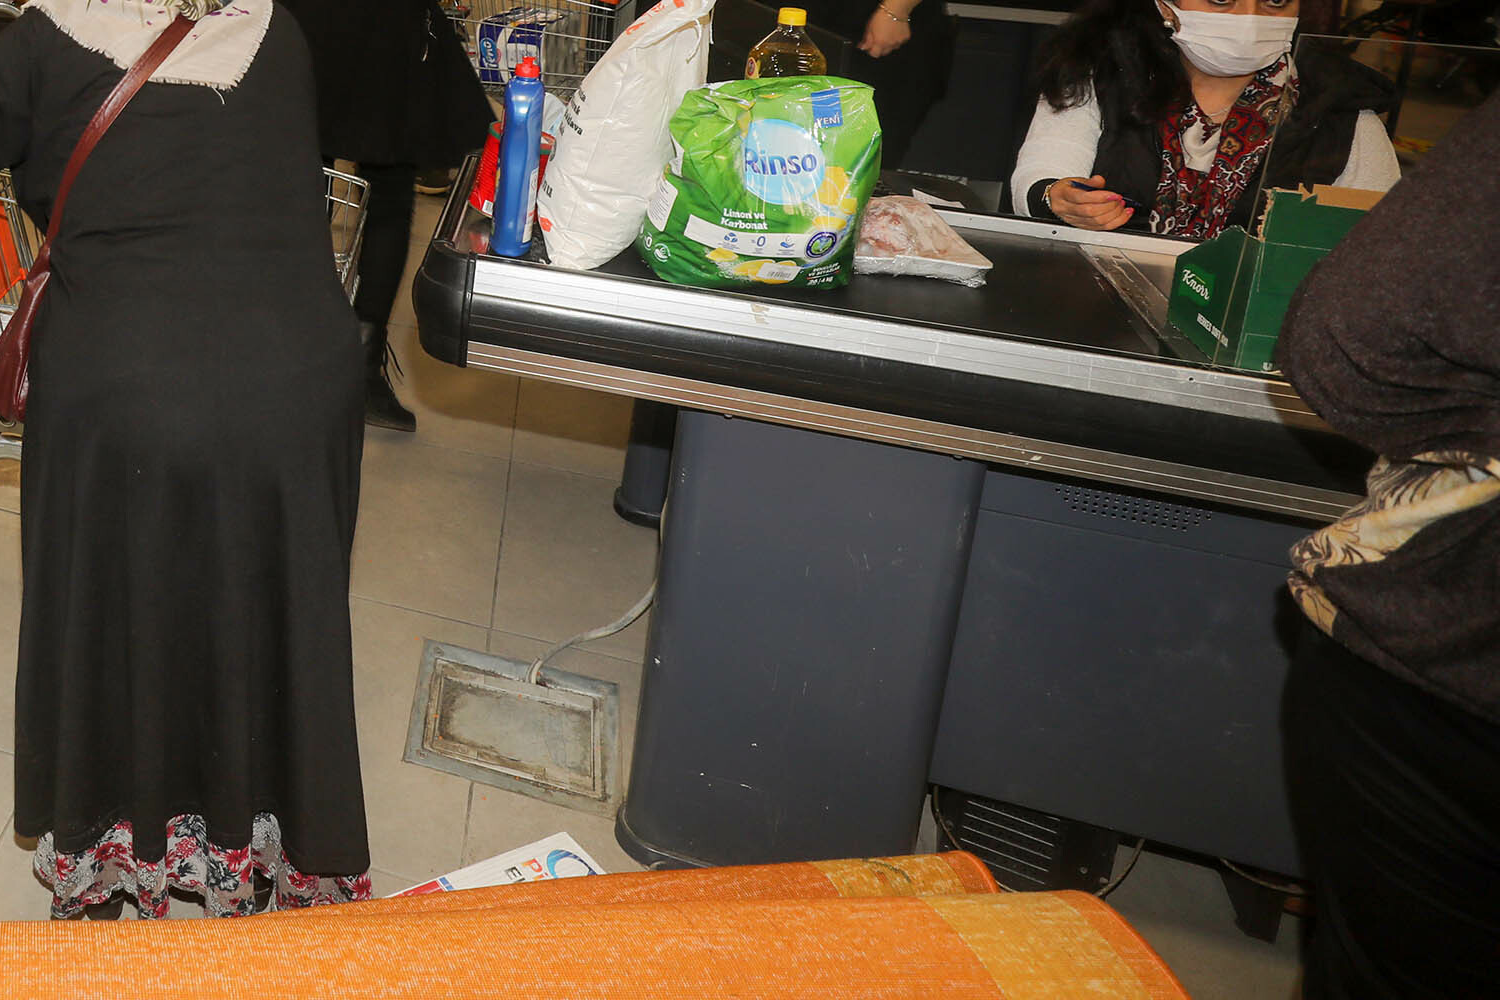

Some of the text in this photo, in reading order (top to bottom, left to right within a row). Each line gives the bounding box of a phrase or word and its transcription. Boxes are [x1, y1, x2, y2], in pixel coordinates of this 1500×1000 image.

[483, 40, 496, 68] Teno
[816, 112, 840, 128] YENİ
[745, 148, 817, 176] Rinso
[721, 217, 768, 230] Karbonat
[723, 208, 749, 219] Limon
[1183, 269, 1210, 300] Knorr
